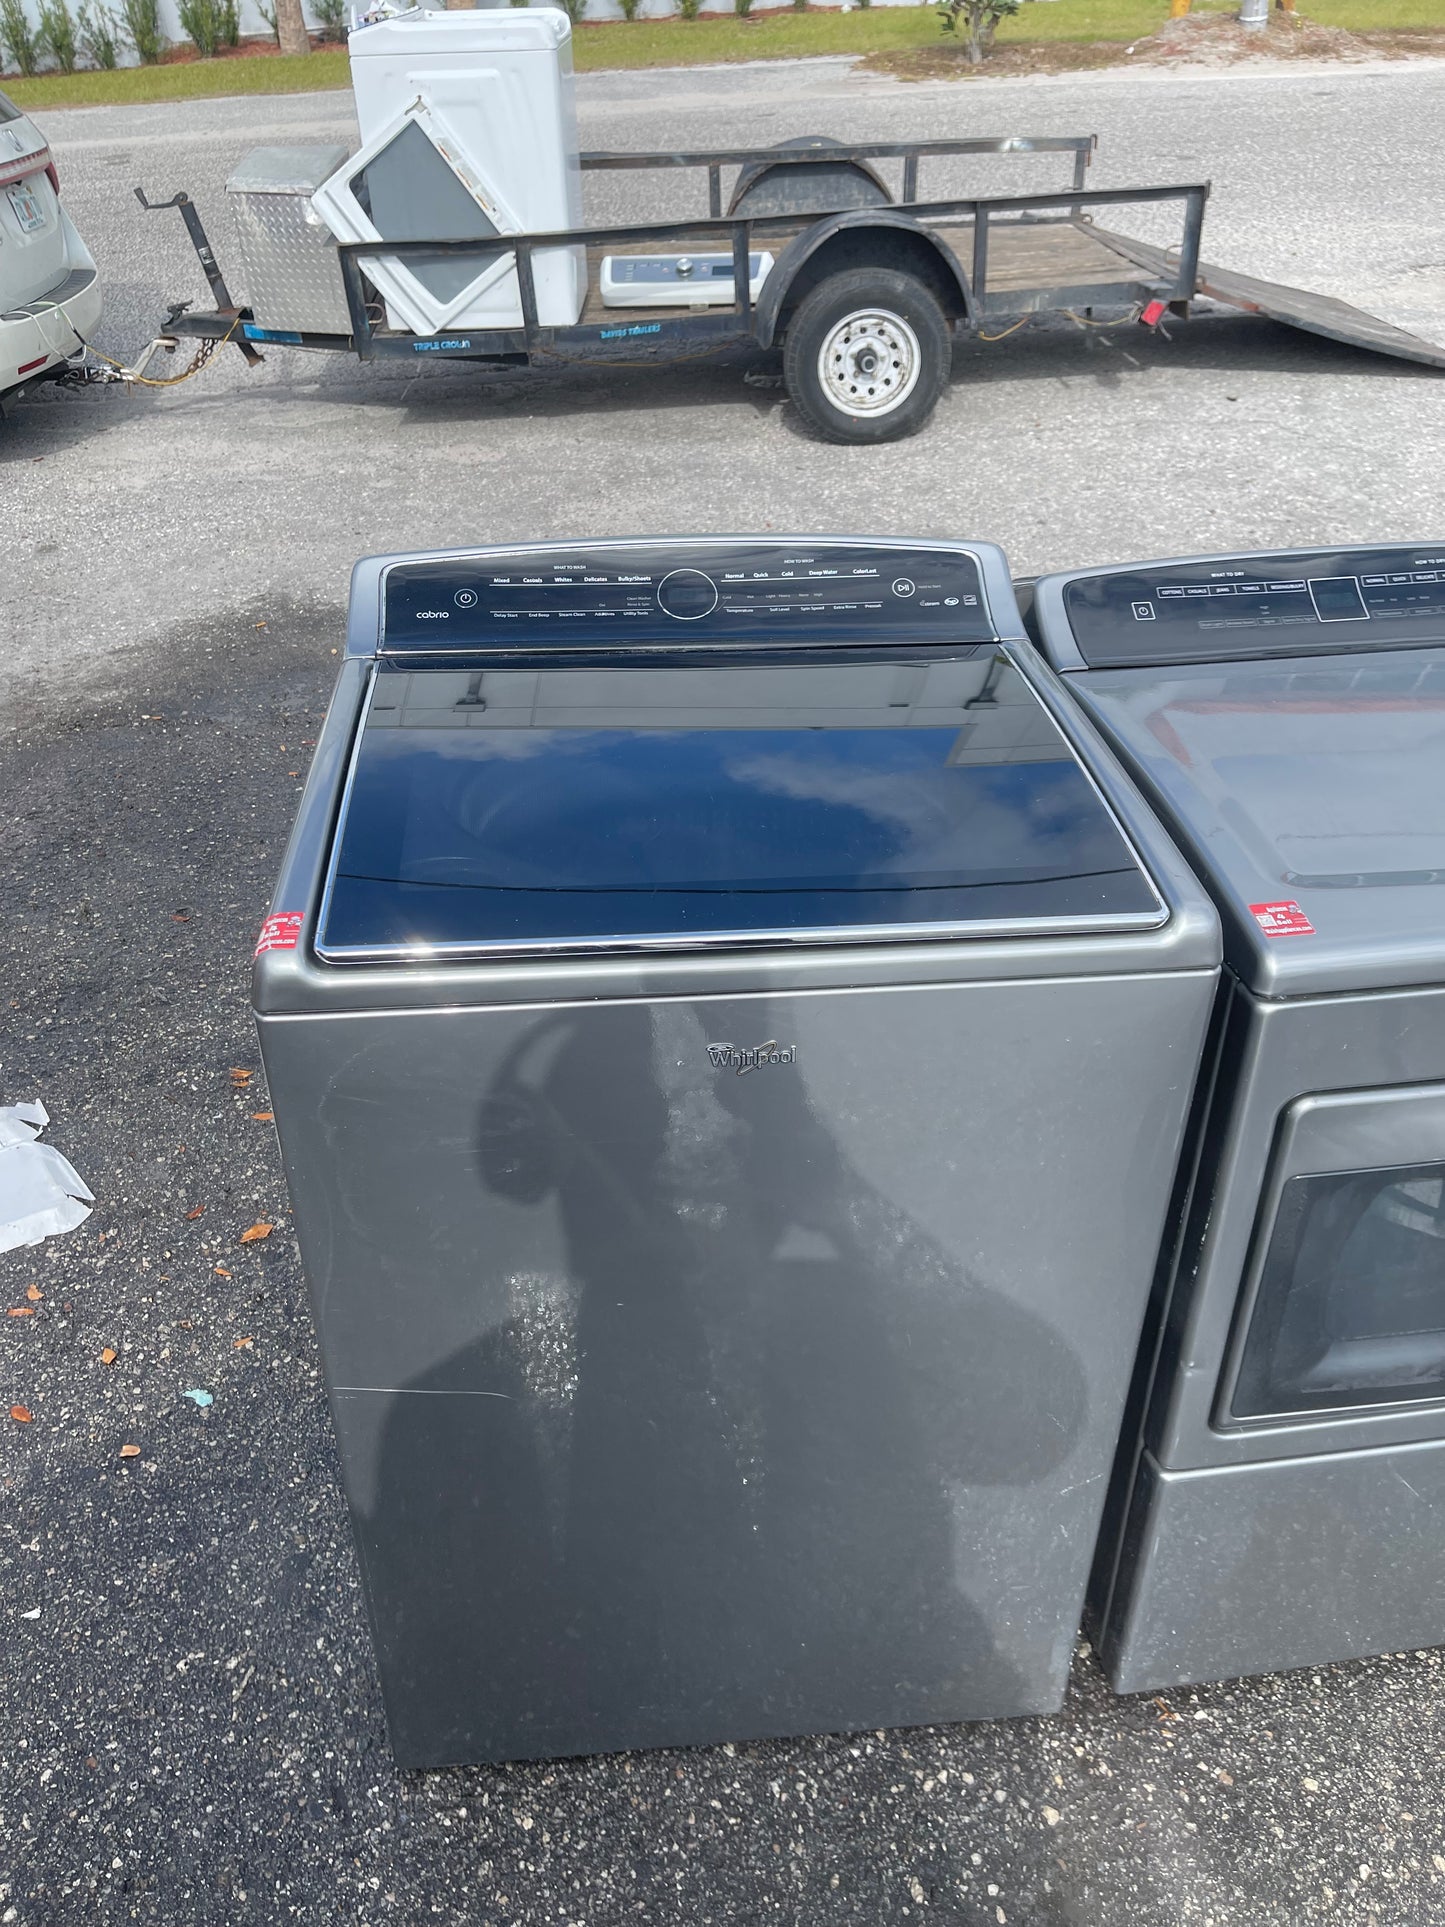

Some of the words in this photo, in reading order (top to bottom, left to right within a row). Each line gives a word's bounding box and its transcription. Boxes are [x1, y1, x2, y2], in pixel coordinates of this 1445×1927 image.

[413, 341, 440, 351] TRIPLE
[440, 339, 471, 349] CROWN
[416, 610, 450, 619] cabrio
[707, 1043, 797, 1071] Whirlpool
